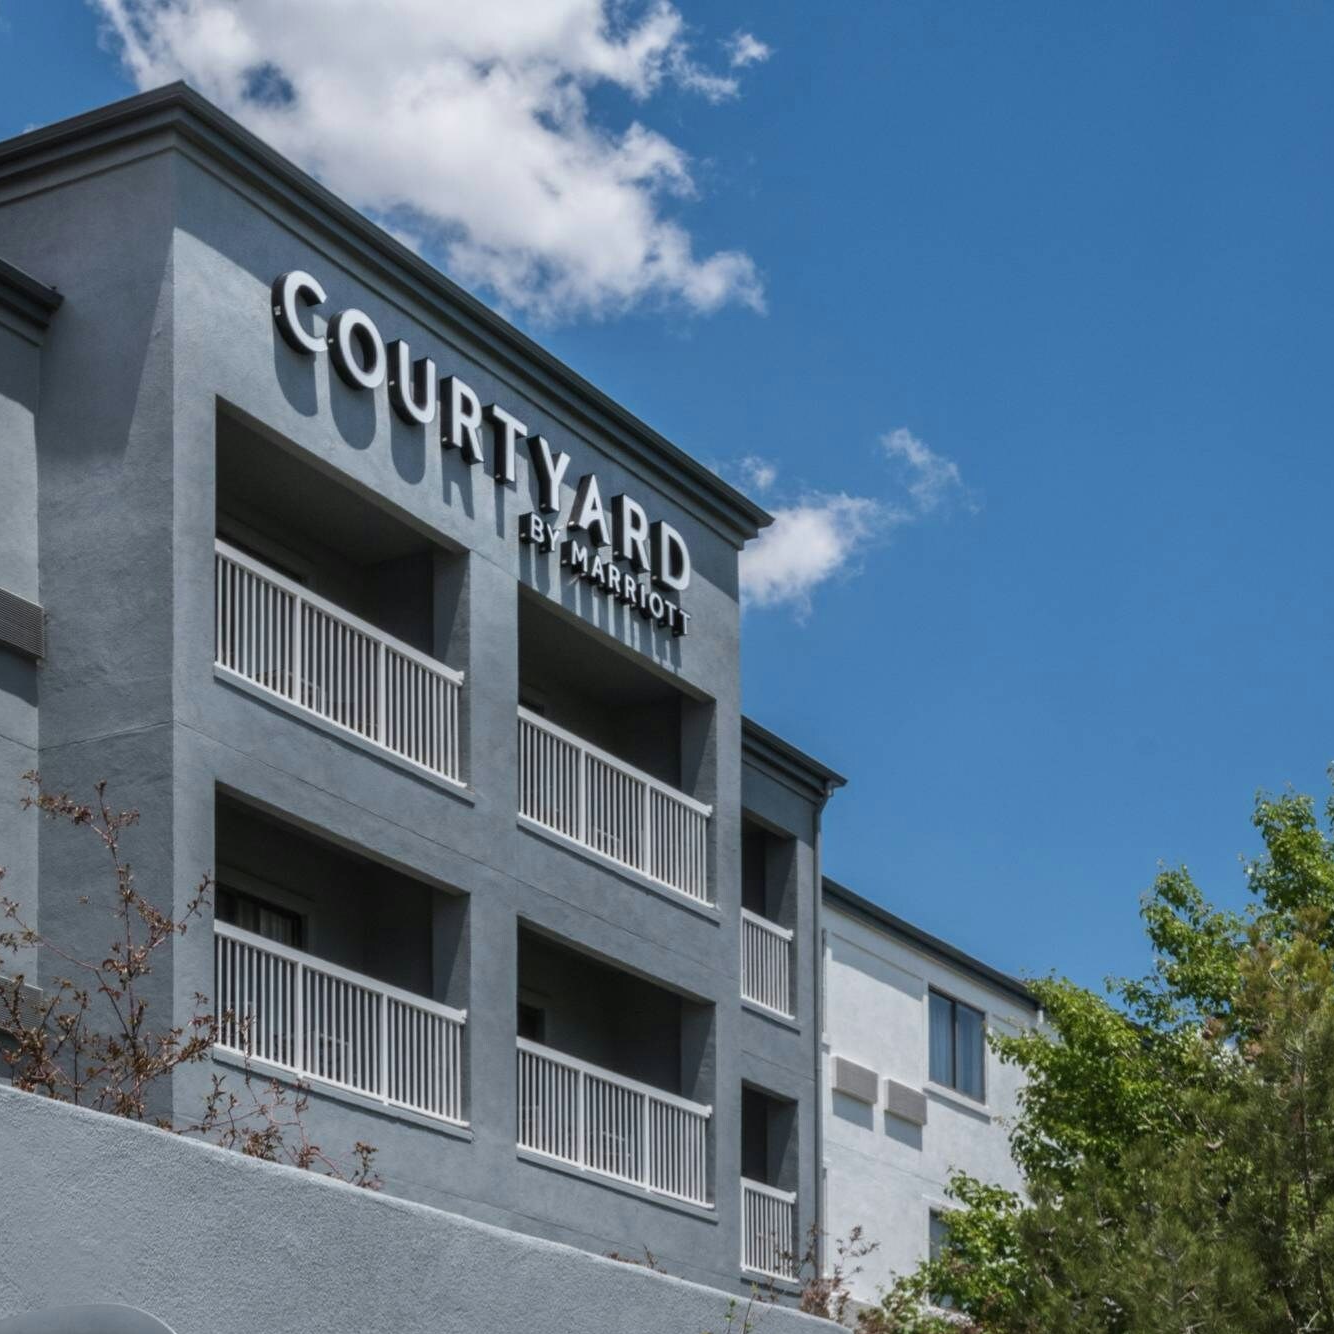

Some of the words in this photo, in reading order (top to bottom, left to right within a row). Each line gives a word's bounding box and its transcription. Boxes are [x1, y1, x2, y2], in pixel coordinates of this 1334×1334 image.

[272, 270, 691, 591] COURTYARD
[520, 511, 560, 553] BY
[561, 540, 691, 636] MARRIOTT
